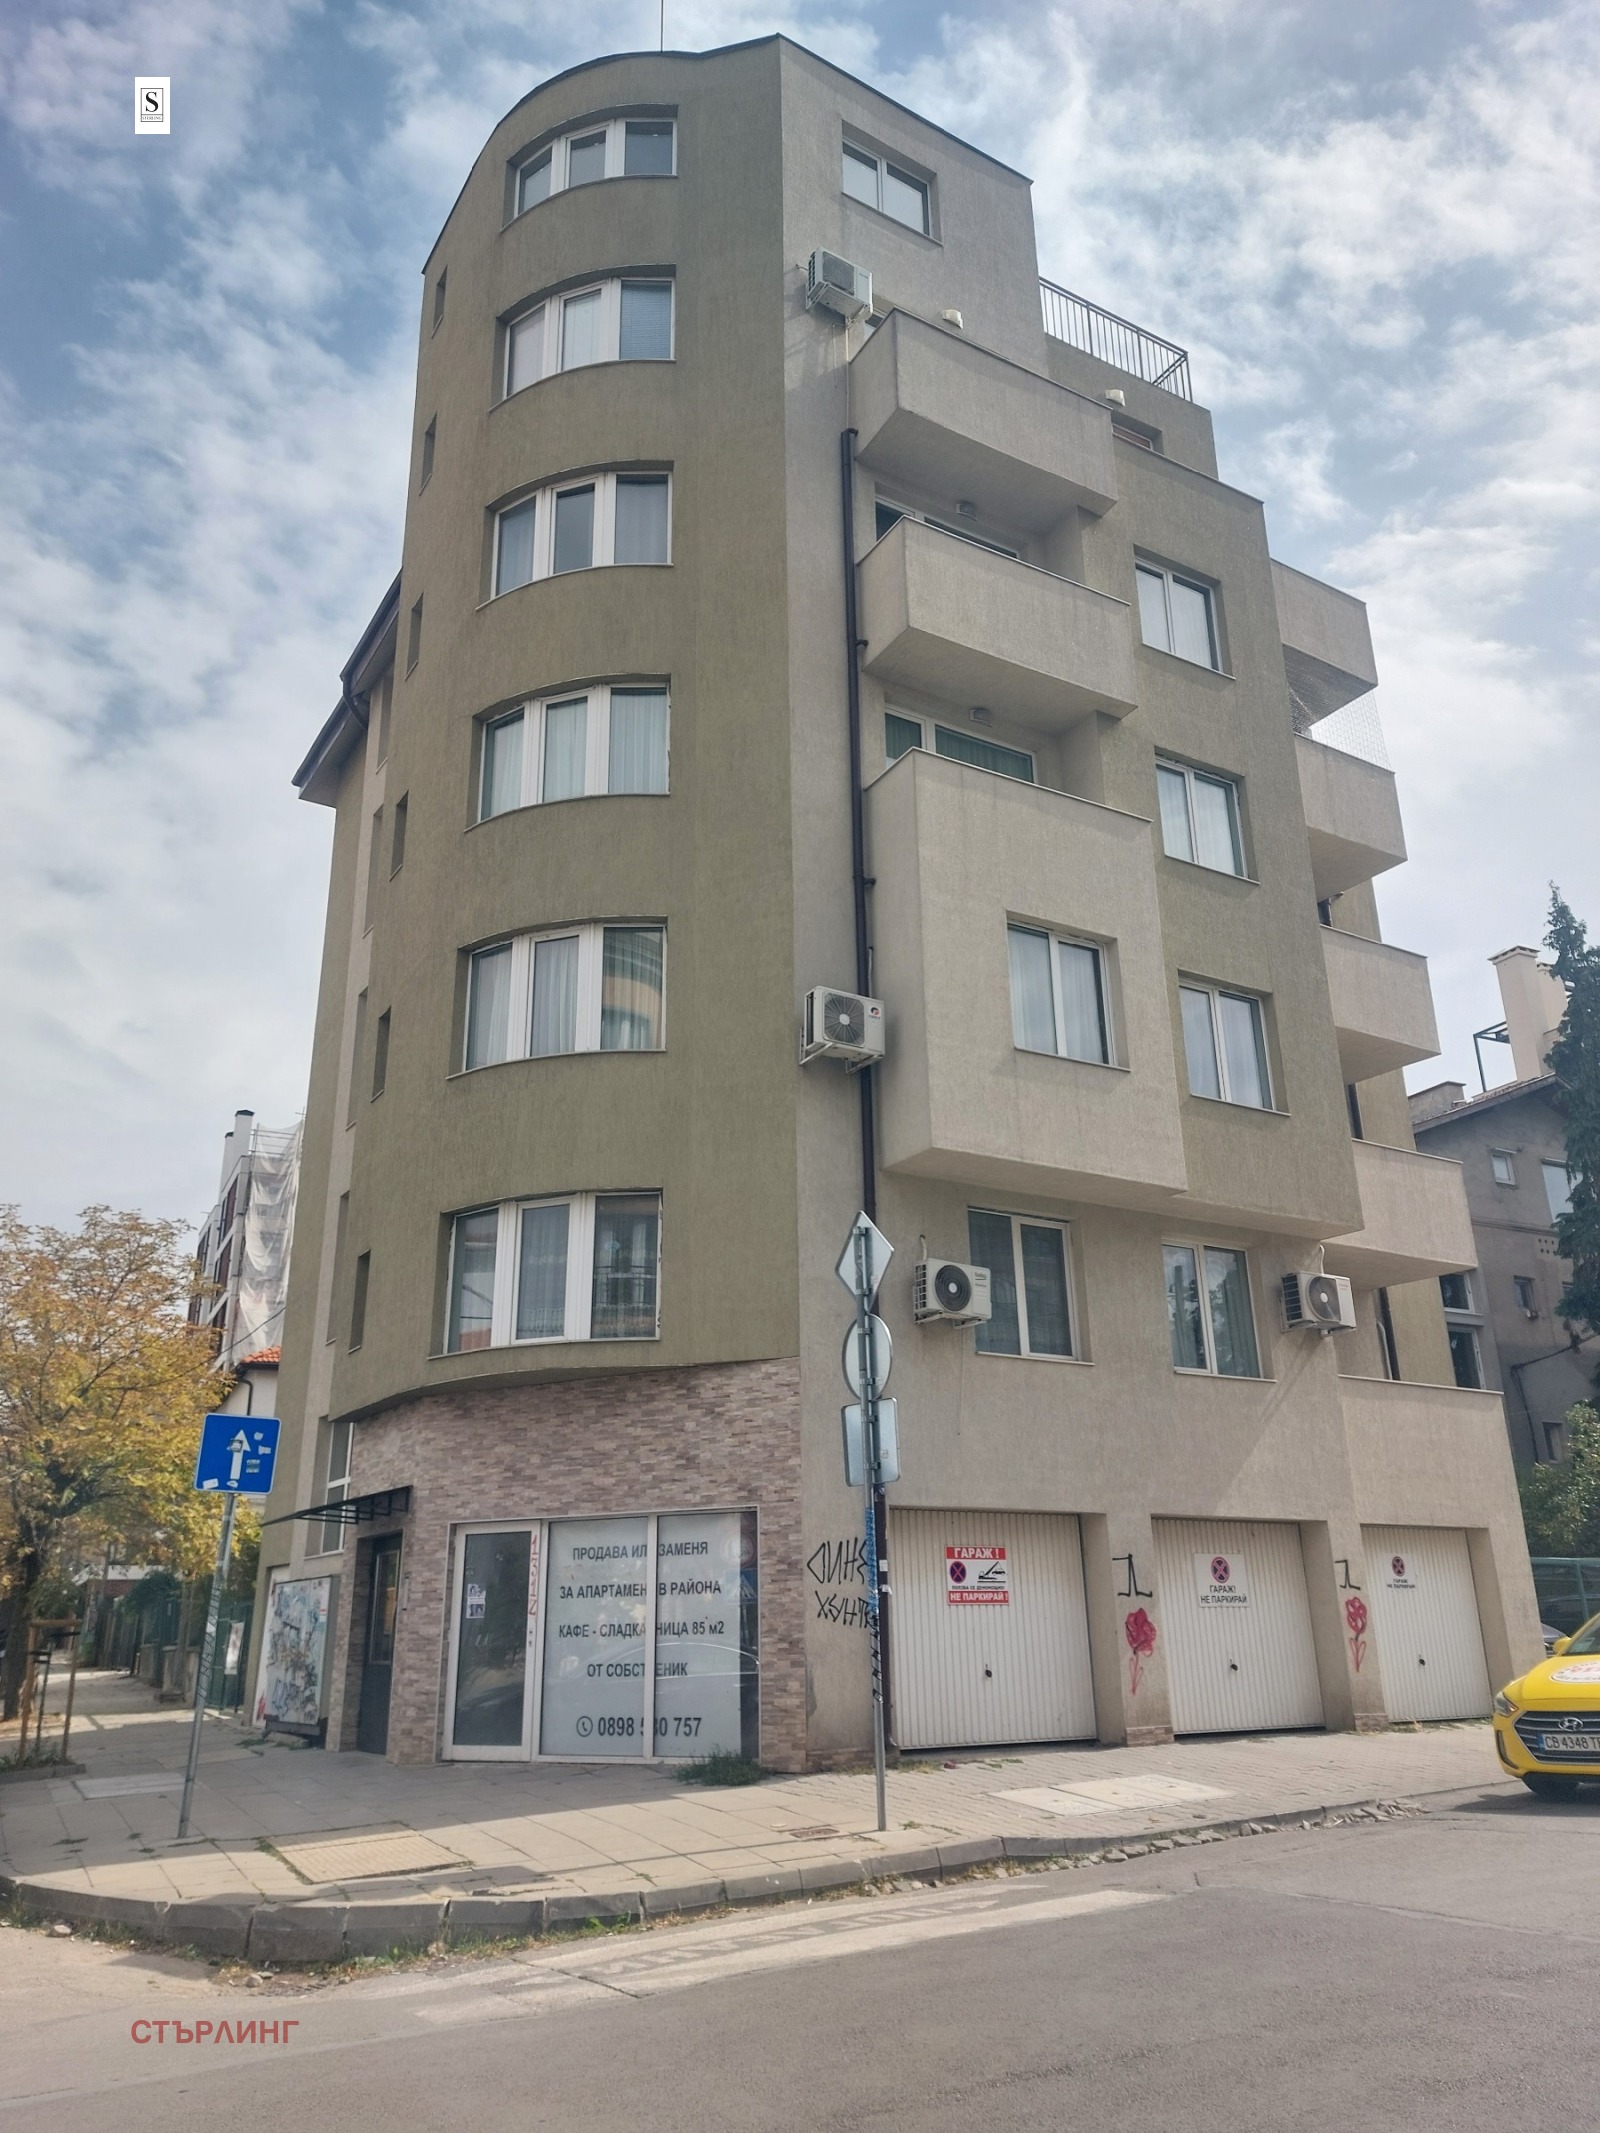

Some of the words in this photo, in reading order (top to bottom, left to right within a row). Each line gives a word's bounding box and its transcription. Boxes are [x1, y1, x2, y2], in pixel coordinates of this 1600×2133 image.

[573, 1546, 628, 1561] ПРОДАВА
[632, 1544, 648, 1557] ИЛ
[659, 1542, 708, 1556] ЗАМЕНЯ
[954, 1547, 994, 1559] ГАРАЖ
[560, 1586, 573, 1599] ЗА
[577, 1583, 647, 1598] АПАРТАМЕН
[659, 1582, 667, 1595] В
[670, 1578, 721, 1595] РАЙОНА
[950, 1592, 961, 1601] НЕ
[962, 1591, 1005, 1601] ПАРКИРАЙ
[1200, 1595, 1211, 1604] НЕ
[1211, 1593, 1248, 1604] ПАРКИРАЙ
[559, 1624, 589, 1638] КАФЕ
[600, 1620, 688, 1639] СЛАДКАНИЦА
[692, 1622, 705, 1635] 85
[709, 1620, 724, 1634] м2
[587, 1663, 603, 1677] ОТ
[606, 1662, 688, 1677] СОБСТЕНИК
[598, 1717, 635, 1736] 0898
[674, 1717, 702, 1736] 757
[1562, 1736, 1589, 1750] 4348
